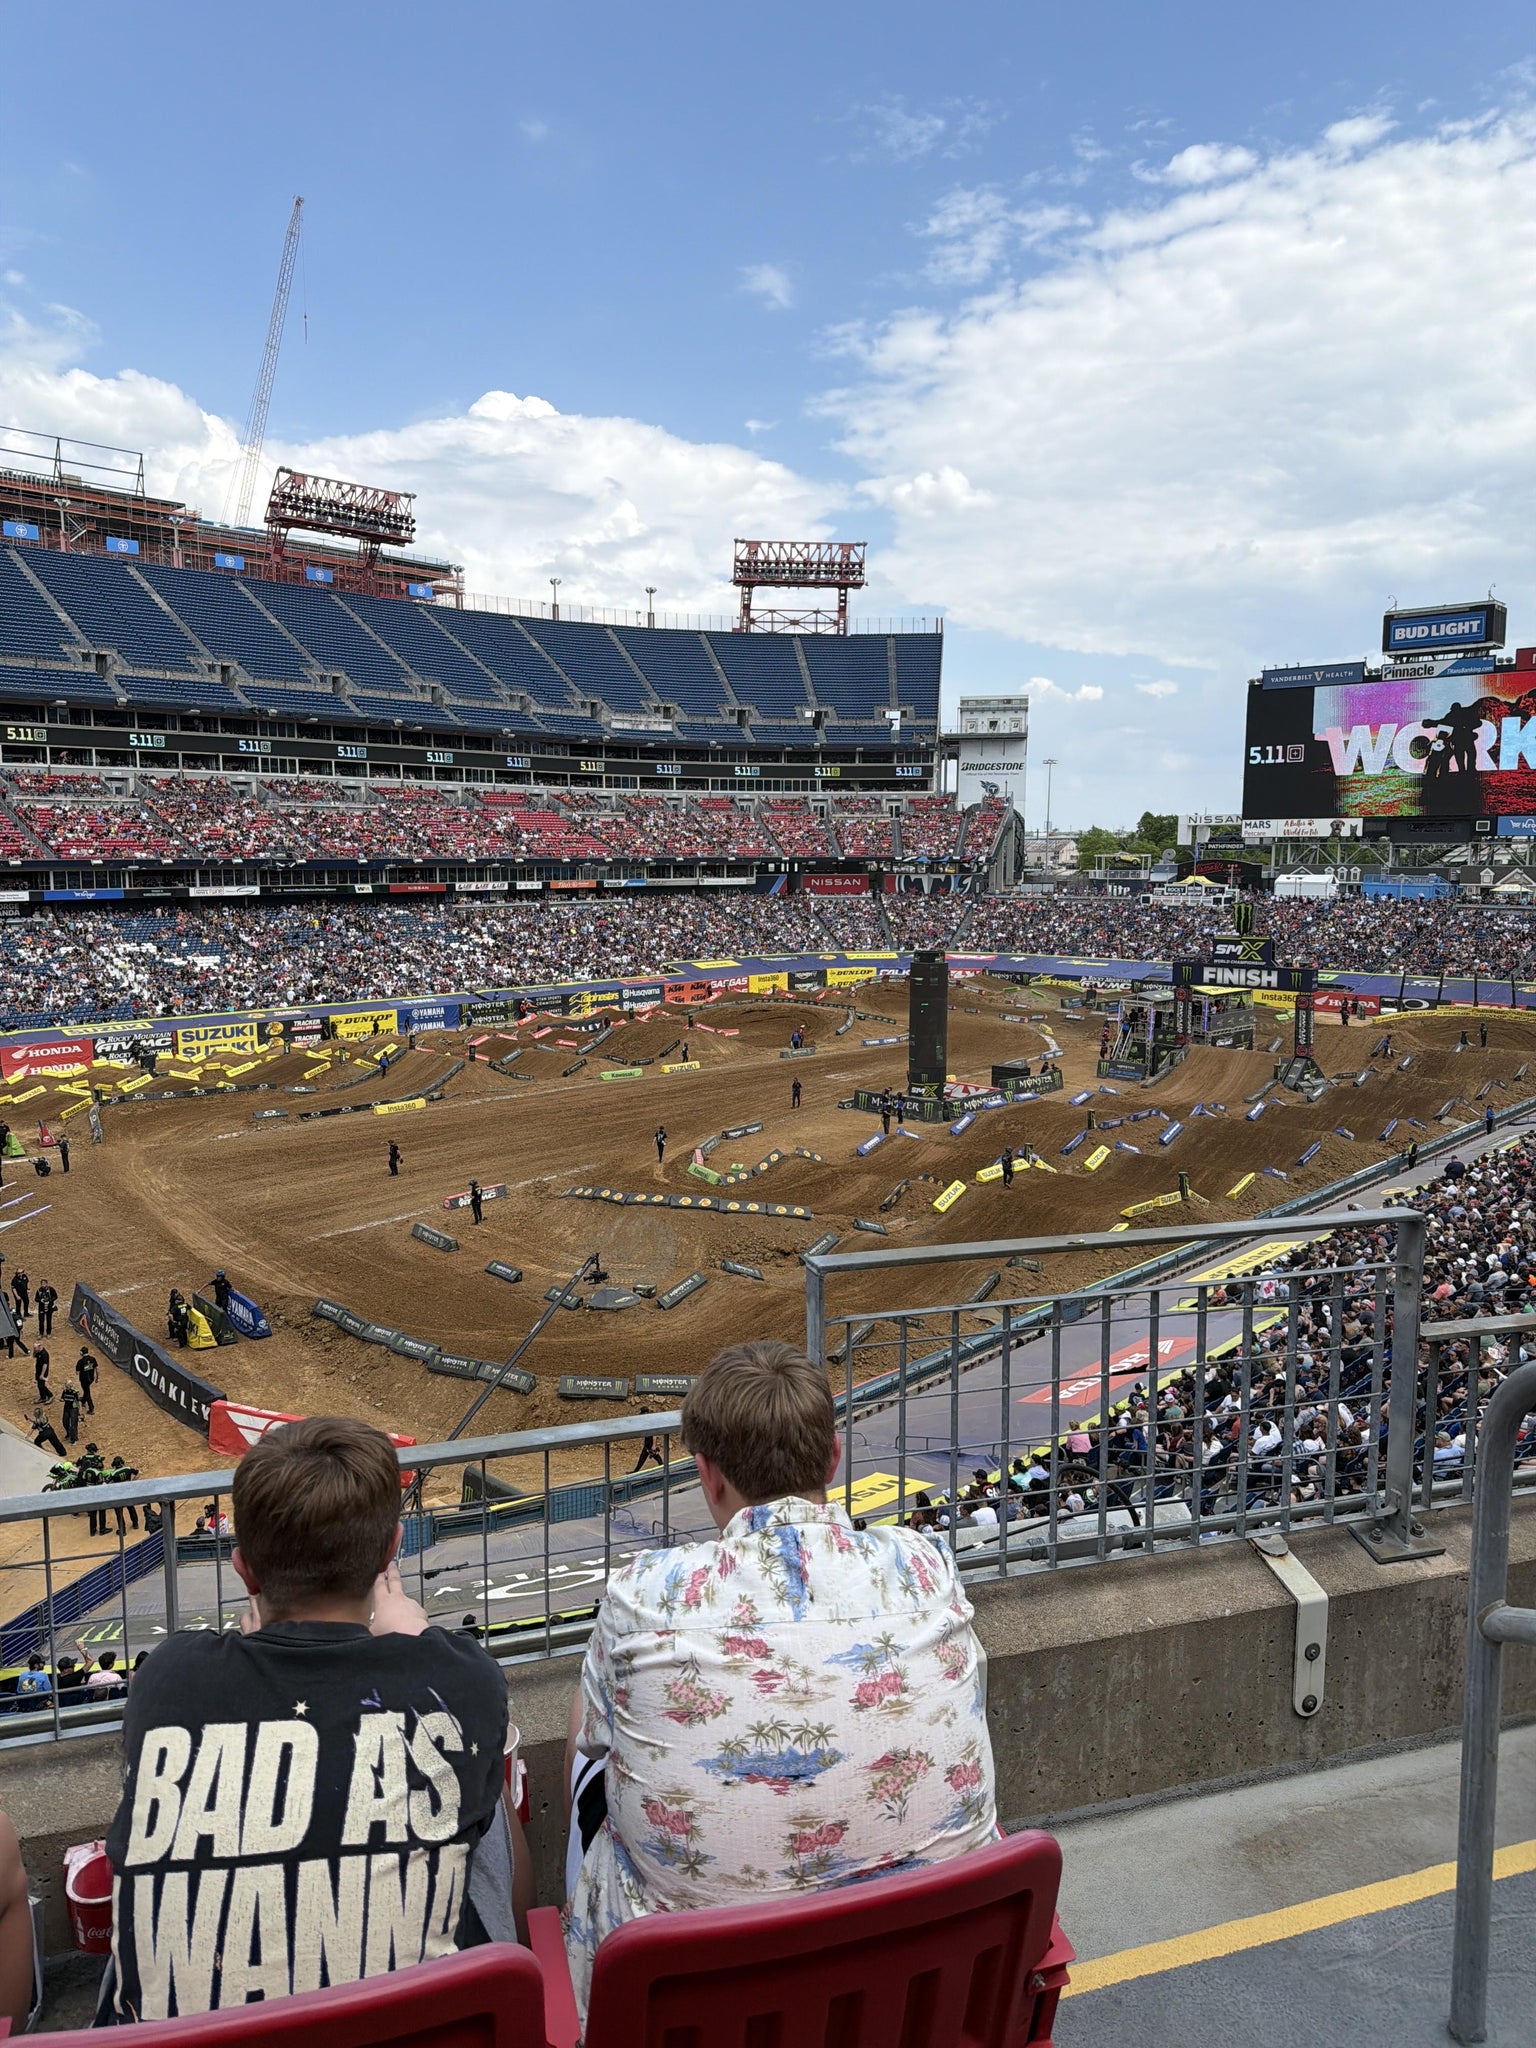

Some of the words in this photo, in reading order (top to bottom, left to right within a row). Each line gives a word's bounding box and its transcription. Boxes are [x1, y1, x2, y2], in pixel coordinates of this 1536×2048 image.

[1395, 624, 1429, 640] BUD
[1430, 620, 1480, 637] LIGHT
[1384, 664, 1434, 679] Pinnacle
[1271, 674, 1312, 682] VANDERBILT
[7, 728, 34, 740] 5.11
[130, 734, 153, 747] 5.11
[239, 740, 260, 752] 5.11
[1326, 716, 1536, 776] WORK
[338, 746, 357, 758] 5.11
[426, 752, 444, 763] 5.11
[1249, 745, 1286, 765] 5.11
[507, 756, 522, 768] 5.11
[580, 761, 596, 771] 5.11
[961, 762, 1024, 770] BRIDGESTONE
[656, 764, 672, 774] 5.11
[734, 766, 752, 776] 5.11
[814, 767, 832, 776] 5.11
[896, 767, 912, 776] 5.11
[1188, 813, 1242, 824] NISSAN
[1244, 820, 1271, 828] MARS
[811, 878, 860, 886] NISSAN
[1214, 941, 1265, 960] SMX
[758, 974, 779, 982] Insta360
[1202, 966, 1278, 988] FINISH
[668, 984, 684, 993] KTM
[690, 982, 706, 990] KTM
[630, 988, 660, 998] Husqvarna
[420, 1007, 445, 1016] YAMAHA
[471, 1002, 505, 1010] MONSTER
[344, 1014, 393, 1024] DUNLOP
[420, 1022, 446, 1030] YAMAHA
[108, 1034, 132, 1043] ROCKY
[132, 1032, 172, 1040] MOUNTAIN
[182, 1024, 254, 1043] SUZUKI
[28, 1045, 82, 1058] HONDA
[669, 1064, 697, 1073] SUZUKI
[1019, 1076, 1052, 1086] MONSTER
[911, 1085, 938, 1098] SMX
[387, 1102, 416, 1112] Insta360
[1088, 1148, 1106, 1167] SUZUKI
[938, 1183, 962, 1208] SUZUKI
[670, 1279, 694, 1298] MONSTER
[232, 1298, 254, 1327] YAMAHA
[442, 1356, 468, 1367] MONSTER
[652, 1378, 688, 1386] MONSTER
[1044, 1352, 1150, 1402] HODA
[576, 1380, 612, 1388] MONSTER
[151, 1369, 210, 1421] OAKLEY
[125, 1719, 318, 1867] BAD
[341, 1710, 464, 1846] AS
